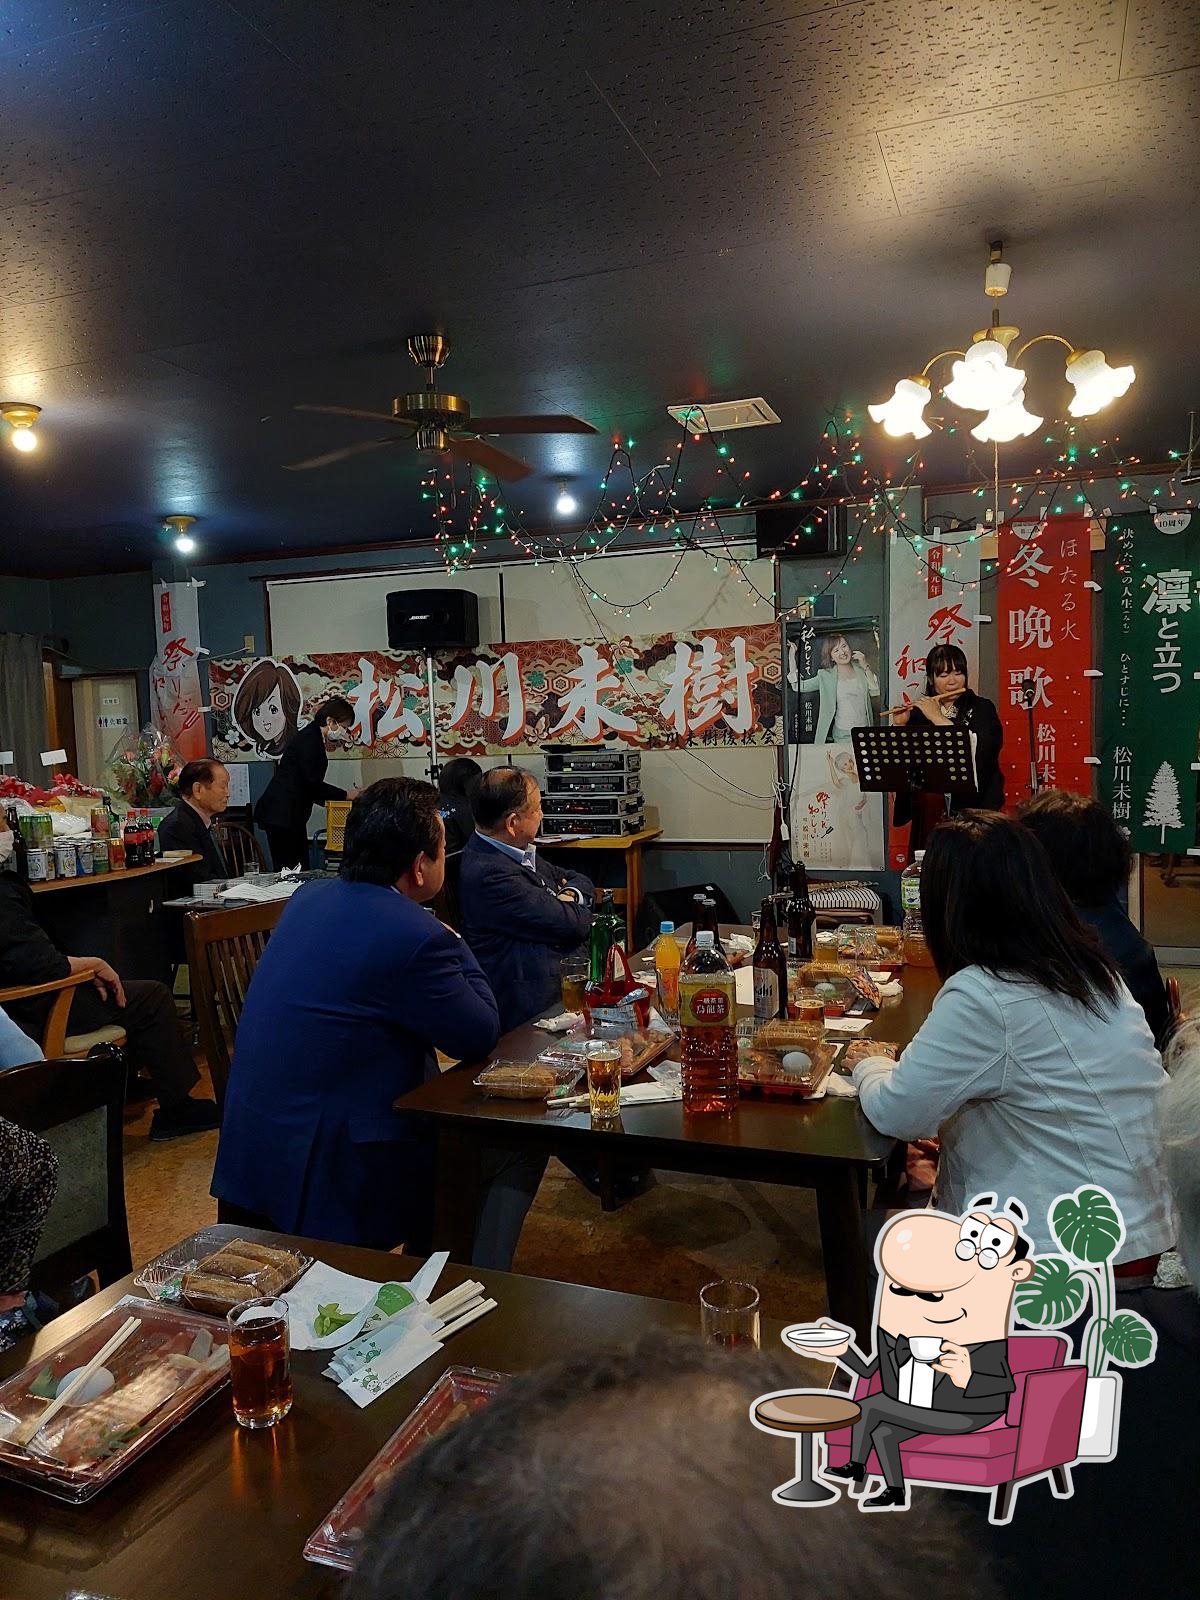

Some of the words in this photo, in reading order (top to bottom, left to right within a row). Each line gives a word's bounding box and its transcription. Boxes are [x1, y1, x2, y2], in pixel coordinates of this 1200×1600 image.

[1159, 519, 1186, 528] 10周年
[930, 549, 941, 596] 令和元年
[1060, 539, 1080, 641] ほたる火
[1007, 543, 1054, 711] 冬晩歌
[1142, 568, 1192, 694] 凛と立つ
[347, 635, 756, 747] 松川未樹
[1037, 723, 1057, 791] 松川未
[1112, 746, 1133, 820] 松川未樹
